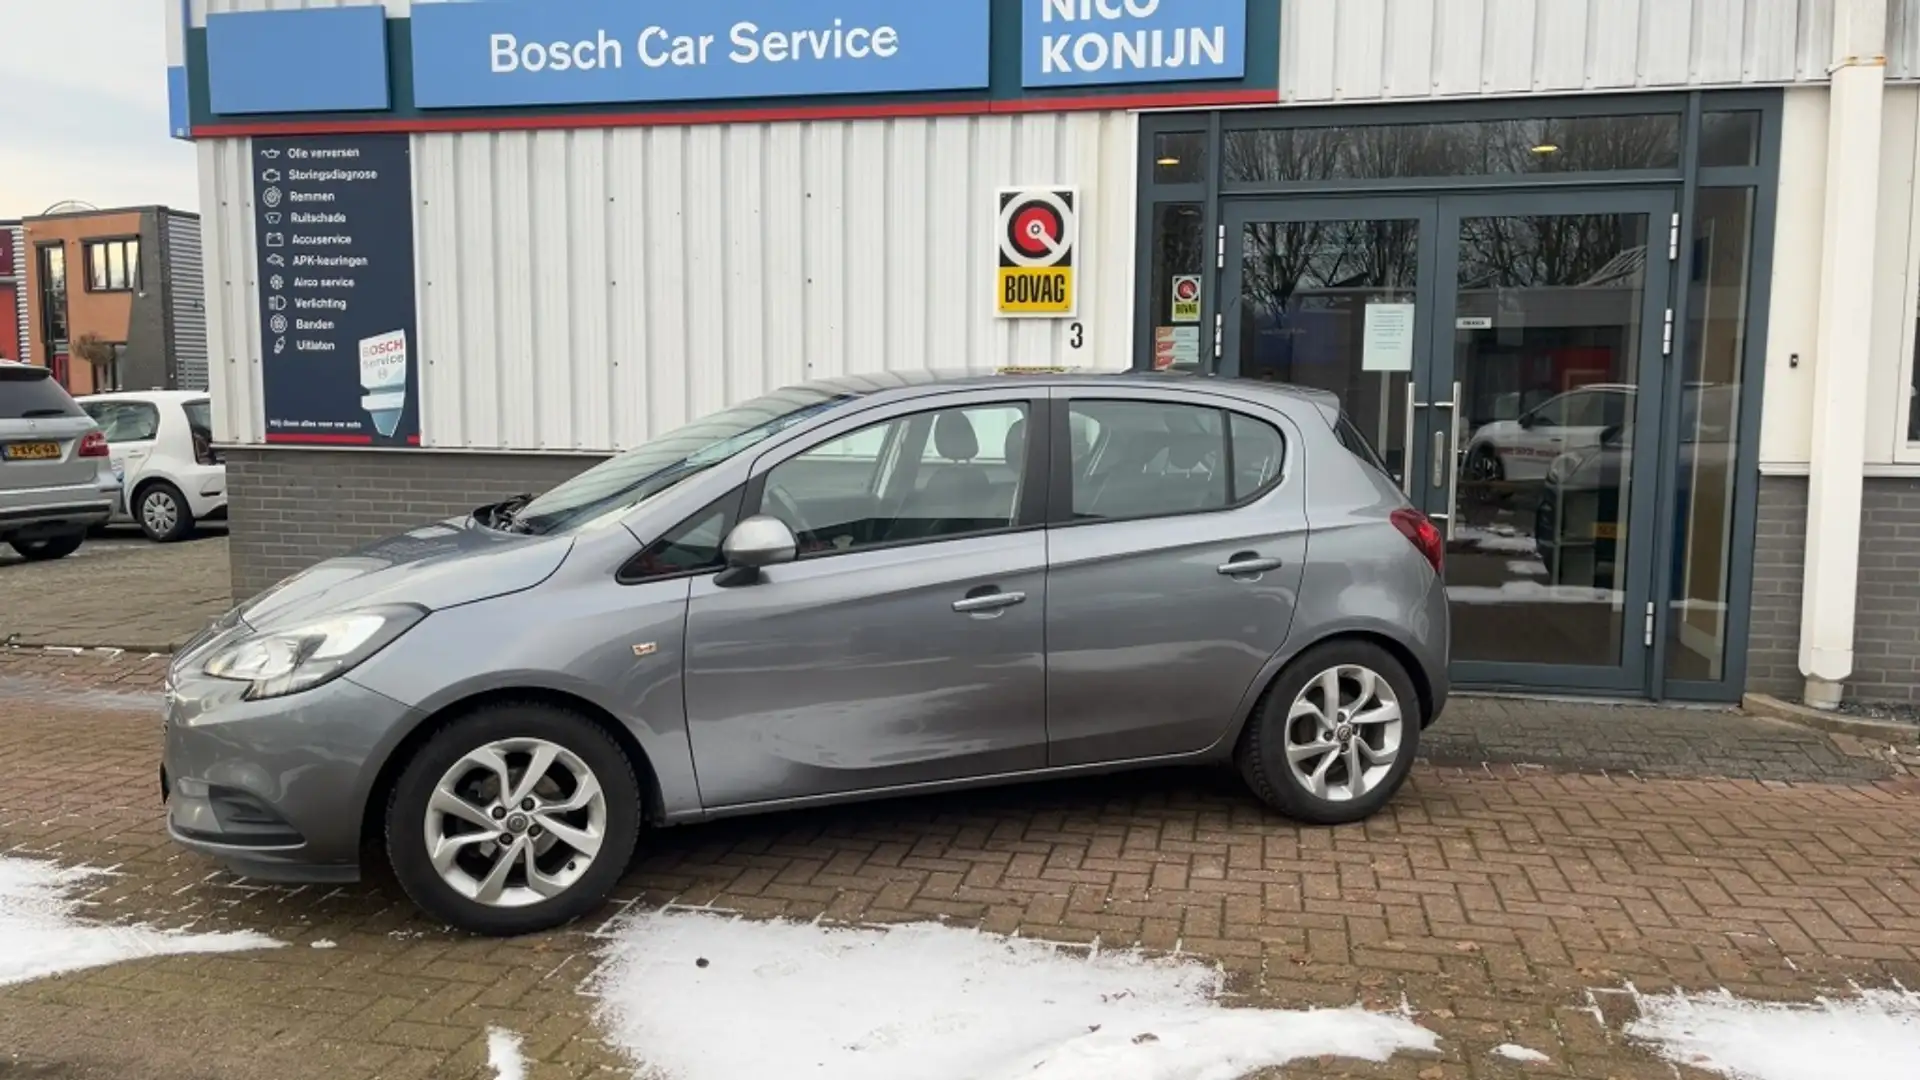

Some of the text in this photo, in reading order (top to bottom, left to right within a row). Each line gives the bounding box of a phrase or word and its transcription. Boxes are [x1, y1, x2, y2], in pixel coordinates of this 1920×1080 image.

[490, 18, 899, 73] Bosch Car Service
[1042, 26, 1225, 73] KONIJN
[287, 148, 360, 159] Olie verversen
[289, 169, 378, 182] Storingsdiagnose
[290, 191, 335, 202] Remmen
[290, 212, 347, 223] Ruitschade
[292, 234, 352, 245] Accuservice
[292, 255, 369, 267] APK-keuringen
[294, 277, 355, 288] Airco service
[1004, 273, 1066, 304] BOVAG
[294, 298, 347, 311] Verlichting
[1175, 303, 1197, 314] BOVAG
[296, 319, 335, 330] Banden
[1070, 322, 1084, 349] 3
[296, 340, 335, 351] Uitlaten
[362, 338, 404, 358] BOSCH
